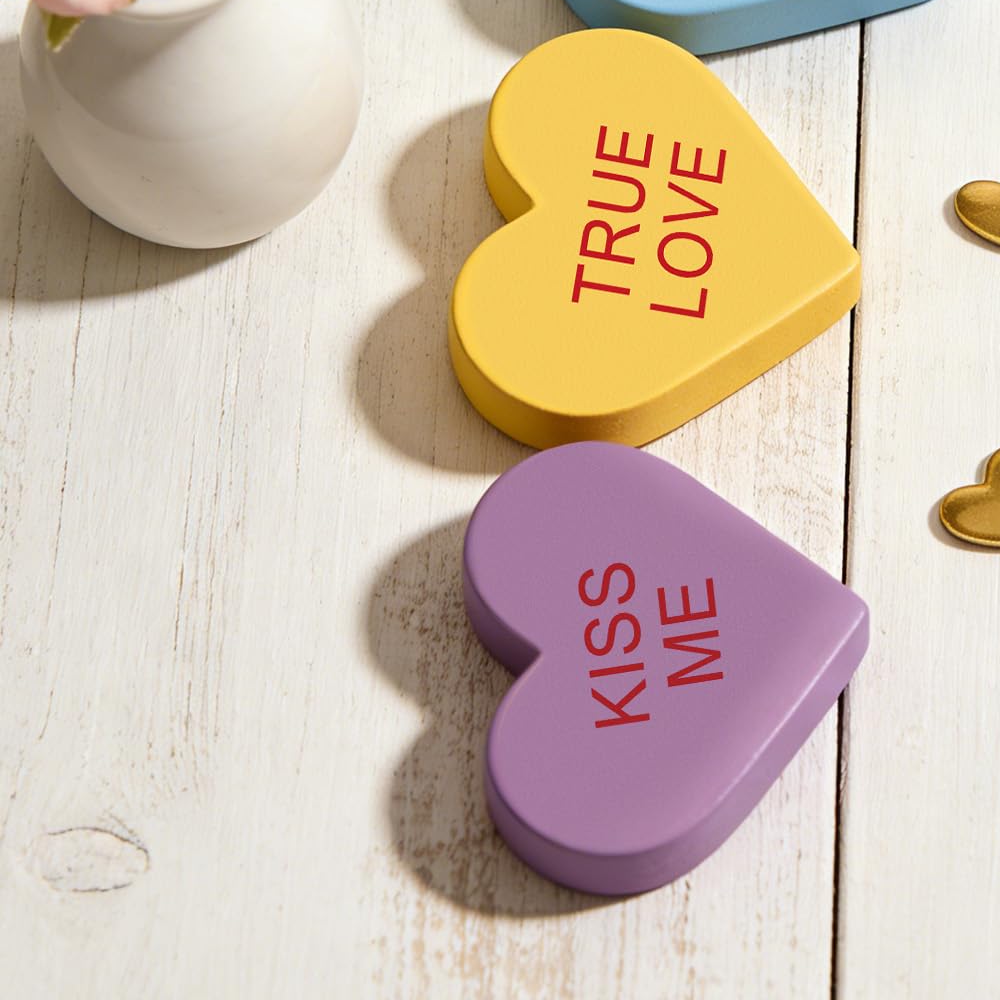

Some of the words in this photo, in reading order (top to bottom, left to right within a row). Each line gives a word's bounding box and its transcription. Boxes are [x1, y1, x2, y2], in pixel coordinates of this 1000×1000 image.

[571, 125, 654, 303] TRUE
[650, 141, 727, 319] LOVE
[578, 563, 650, 728] KISS
[657, 578, 724, 687] ME
